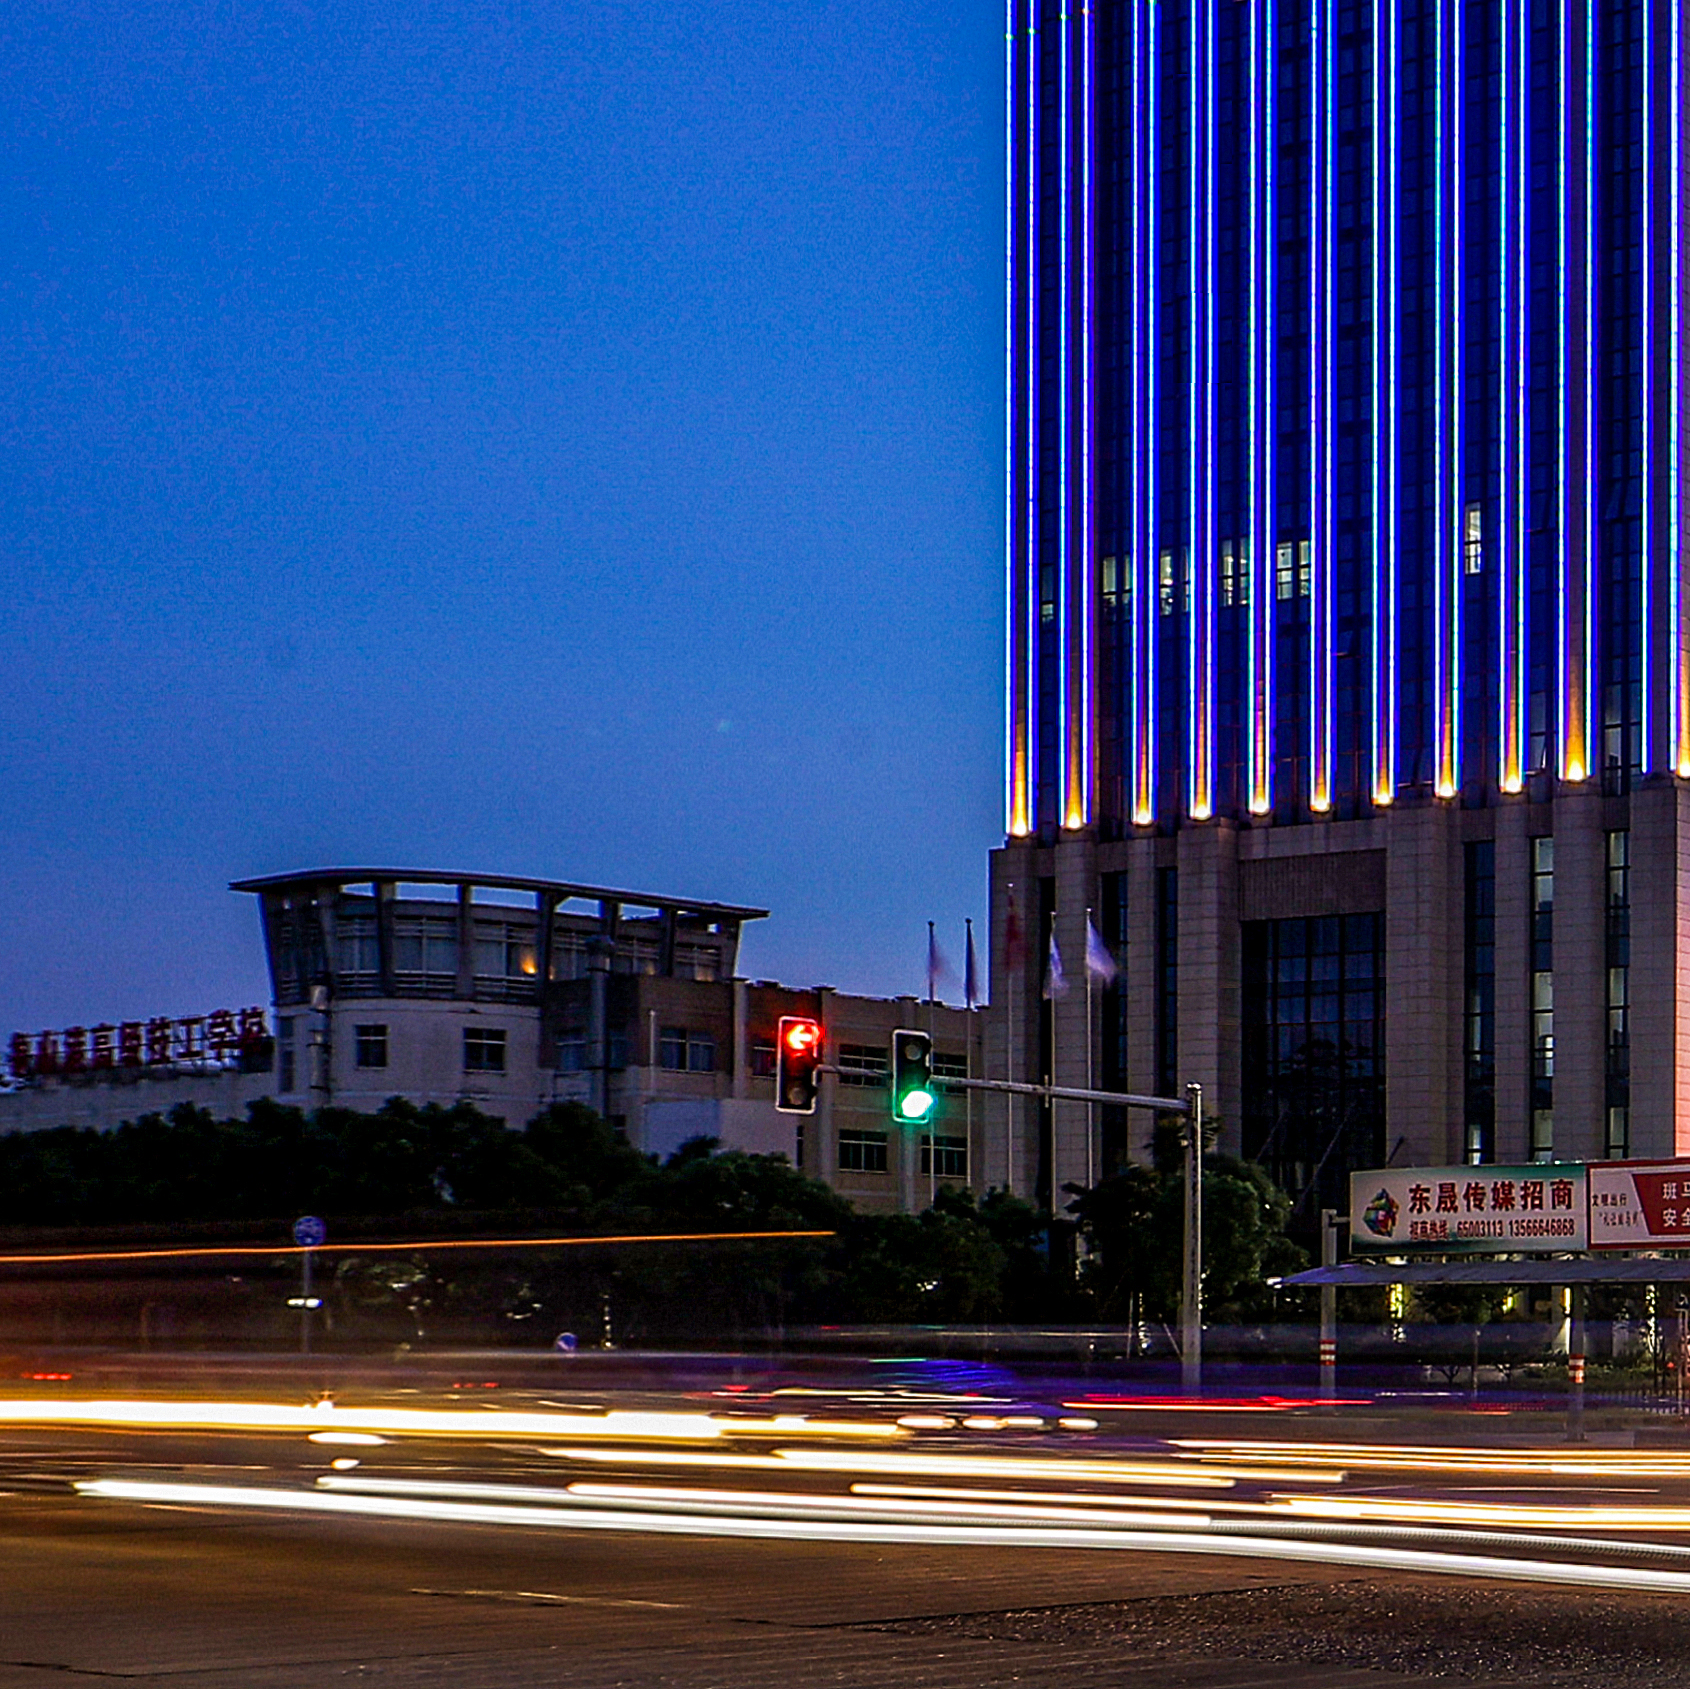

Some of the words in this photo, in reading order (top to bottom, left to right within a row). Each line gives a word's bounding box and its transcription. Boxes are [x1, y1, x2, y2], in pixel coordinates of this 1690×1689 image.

[1408, 1178, 1575, 1215] 东晟传媒招商
[1456, 1219, 1505, 1238] 65003113
